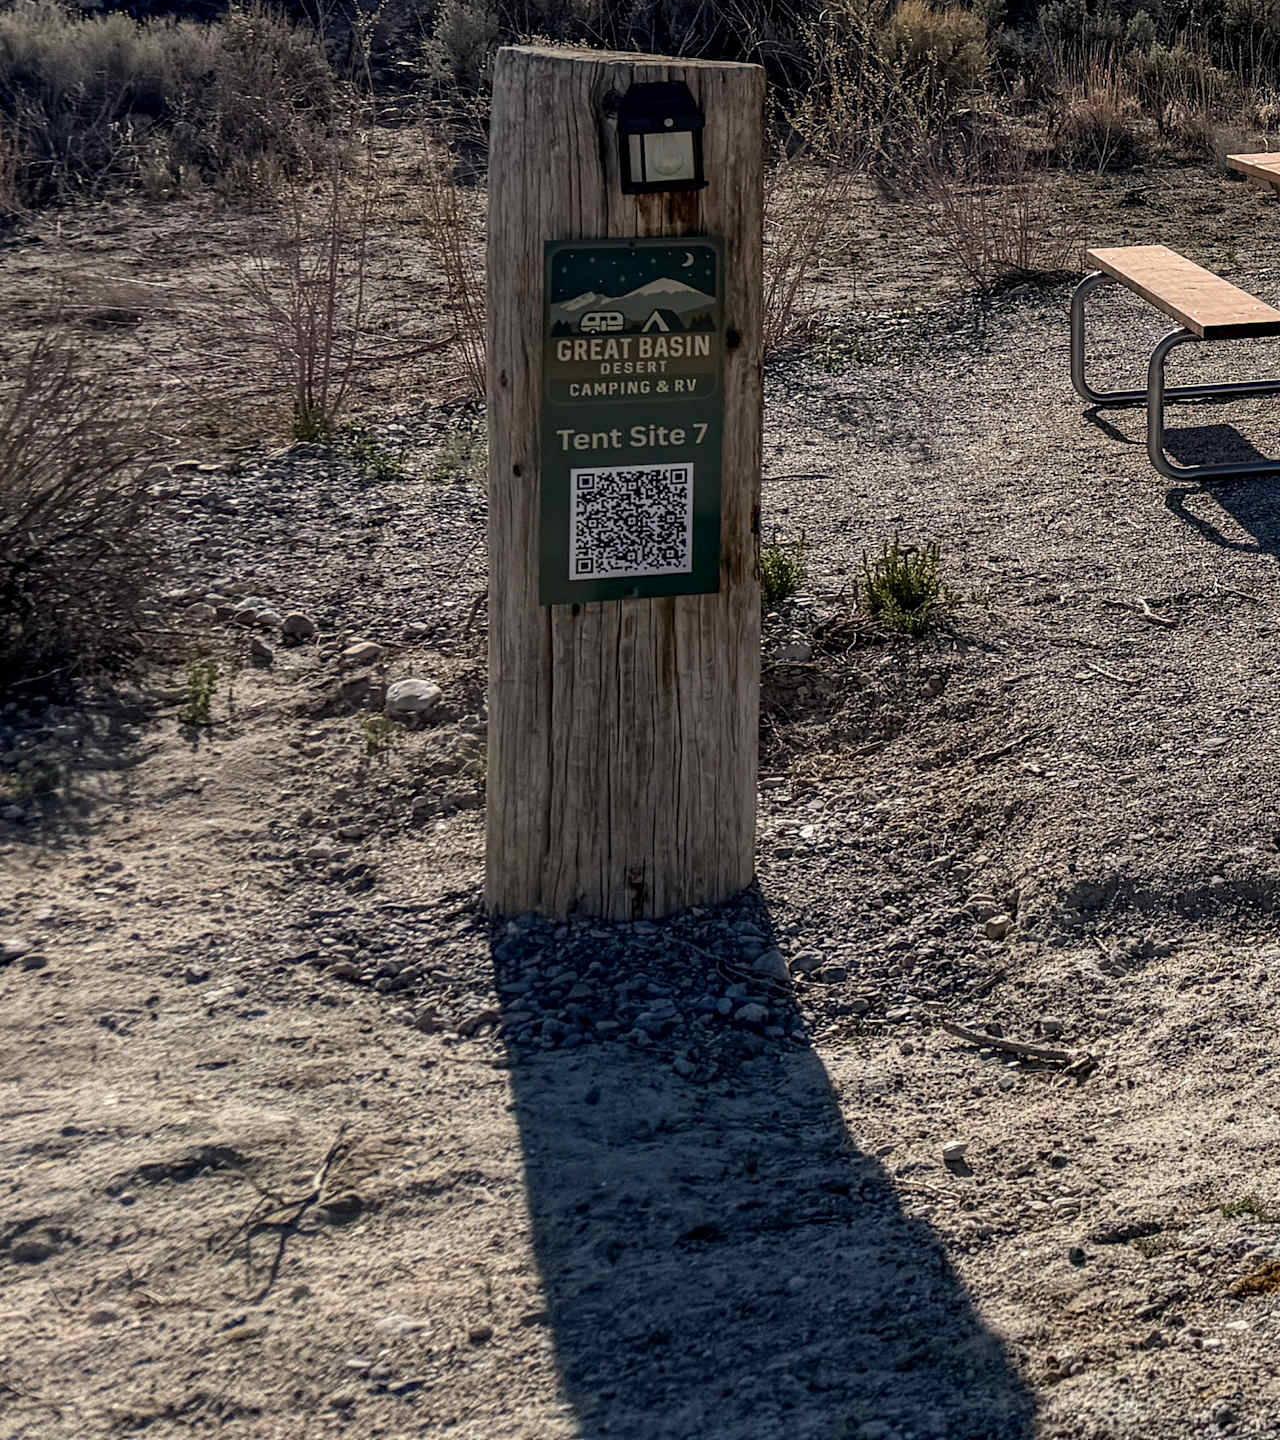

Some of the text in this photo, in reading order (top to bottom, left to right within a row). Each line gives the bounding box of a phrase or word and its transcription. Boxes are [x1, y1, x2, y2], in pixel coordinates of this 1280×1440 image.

[557, 335, 710, 361] GREAT BASIN
[601, 360, 668, 375] DESERT
[570, 378, 697, 397] CAMPING & RV
[556, 423, 709, 451] Tent Site 7
